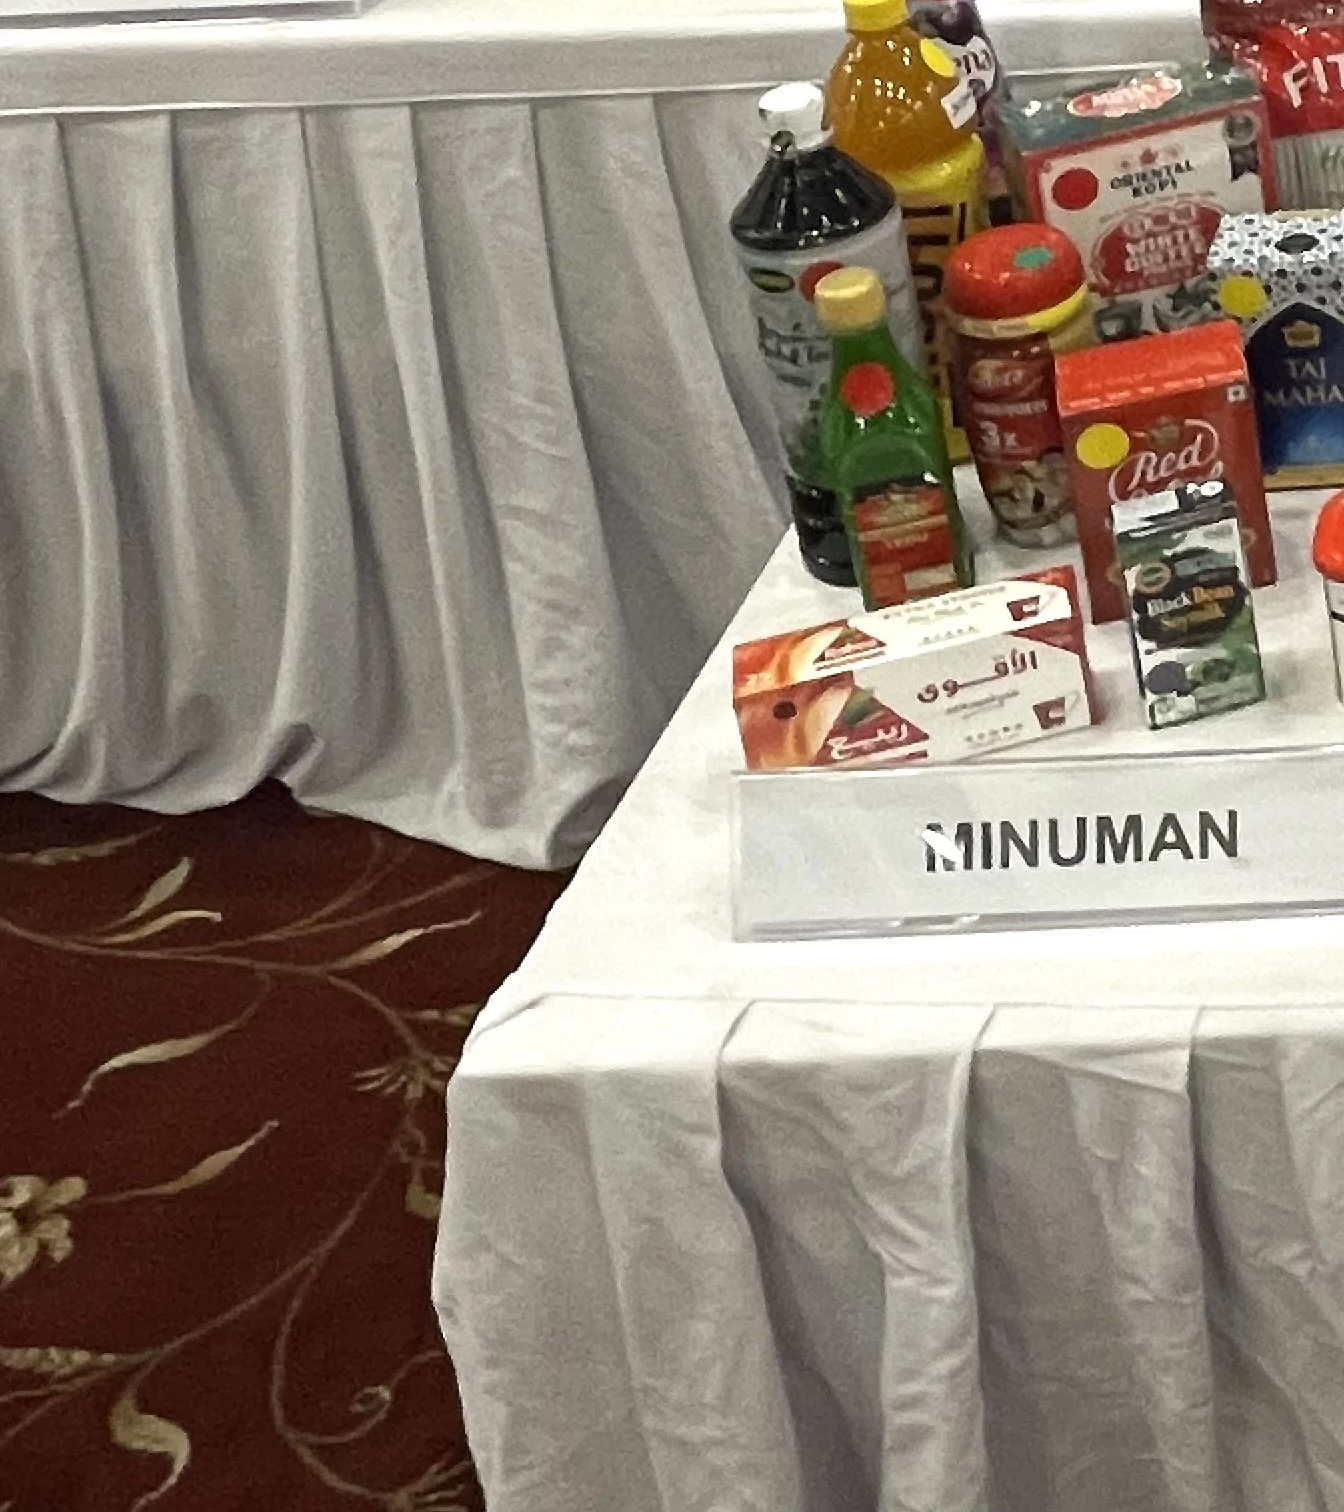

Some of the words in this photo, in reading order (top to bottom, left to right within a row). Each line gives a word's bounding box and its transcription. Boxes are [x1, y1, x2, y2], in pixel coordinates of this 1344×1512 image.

[1286, 357, 1327, 380] TAJ
[1129, 430, 1205, 487] Red
[924, 808, 1239, 874] MINUMAN
